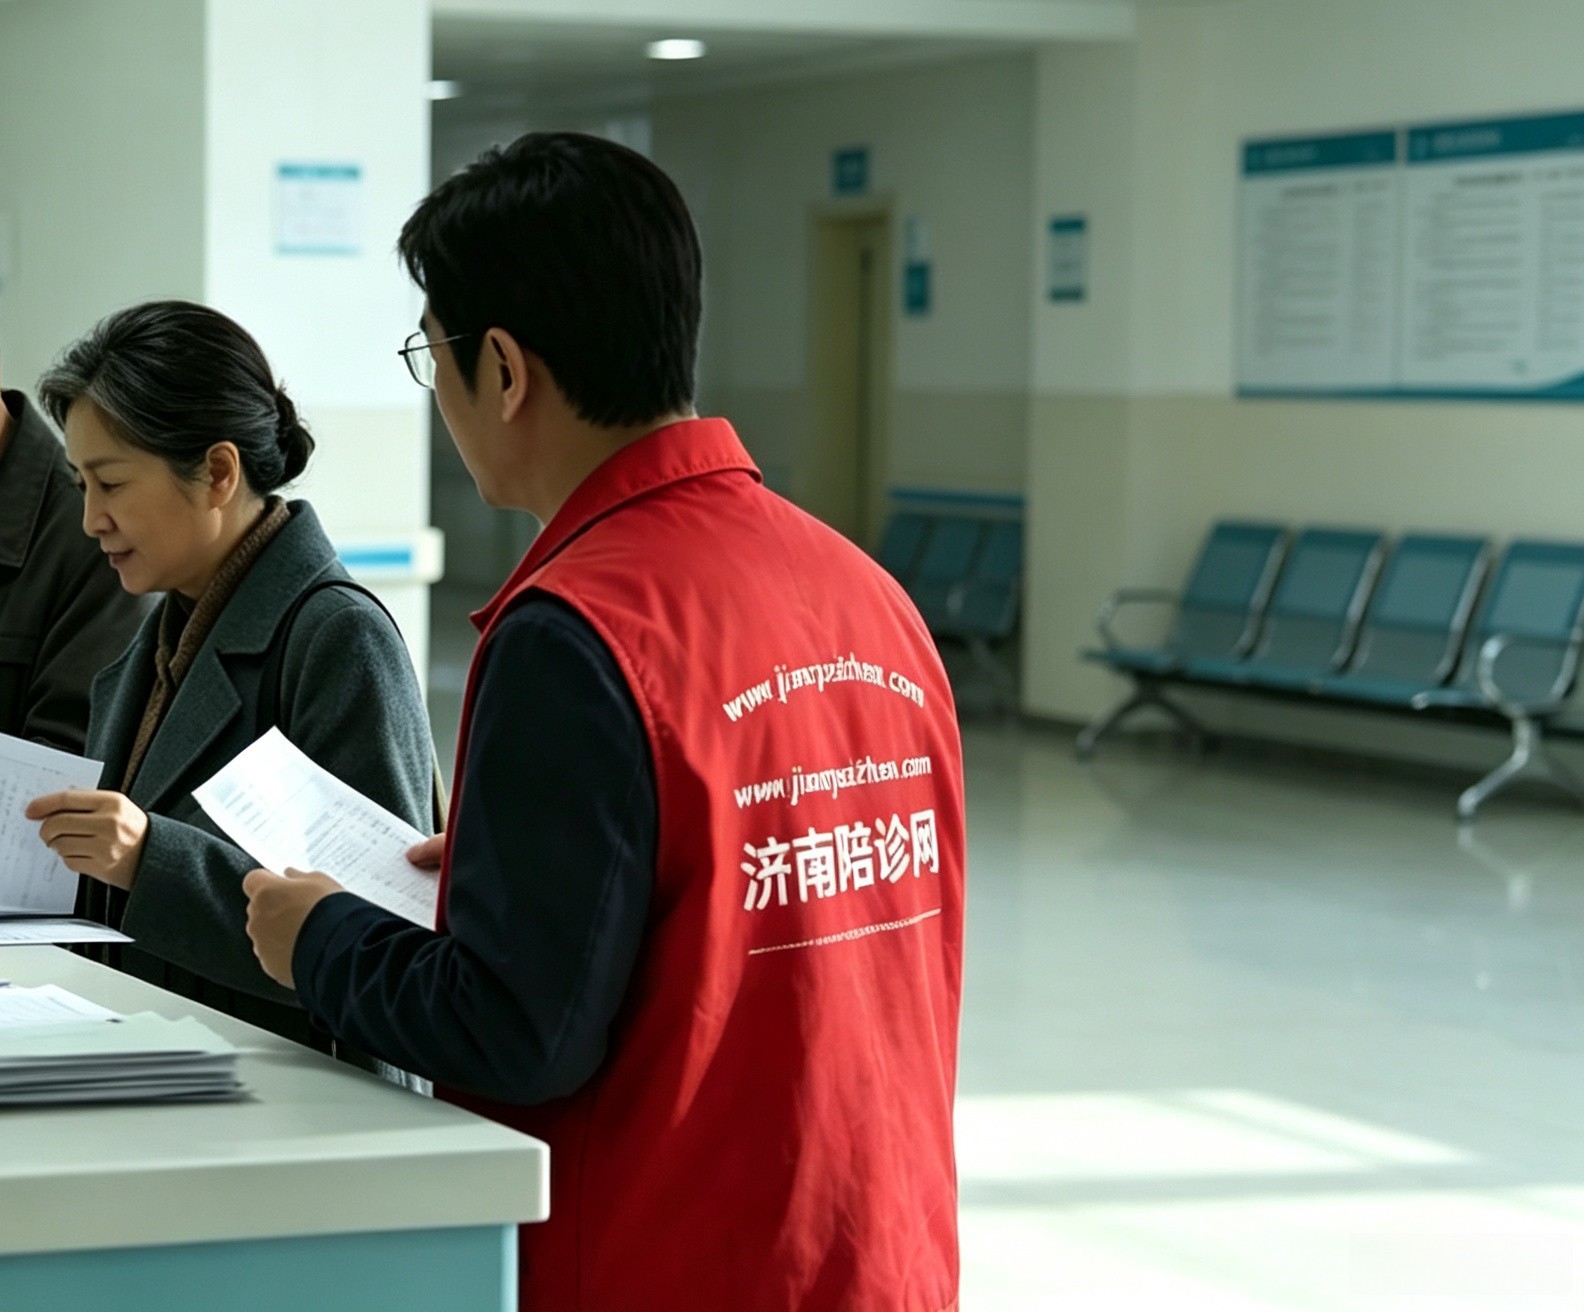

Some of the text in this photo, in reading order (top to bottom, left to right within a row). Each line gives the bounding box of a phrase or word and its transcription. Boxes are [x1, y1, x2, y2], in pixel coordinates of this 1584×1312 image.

[740, 809, 940, 911] 济南陪诊网
